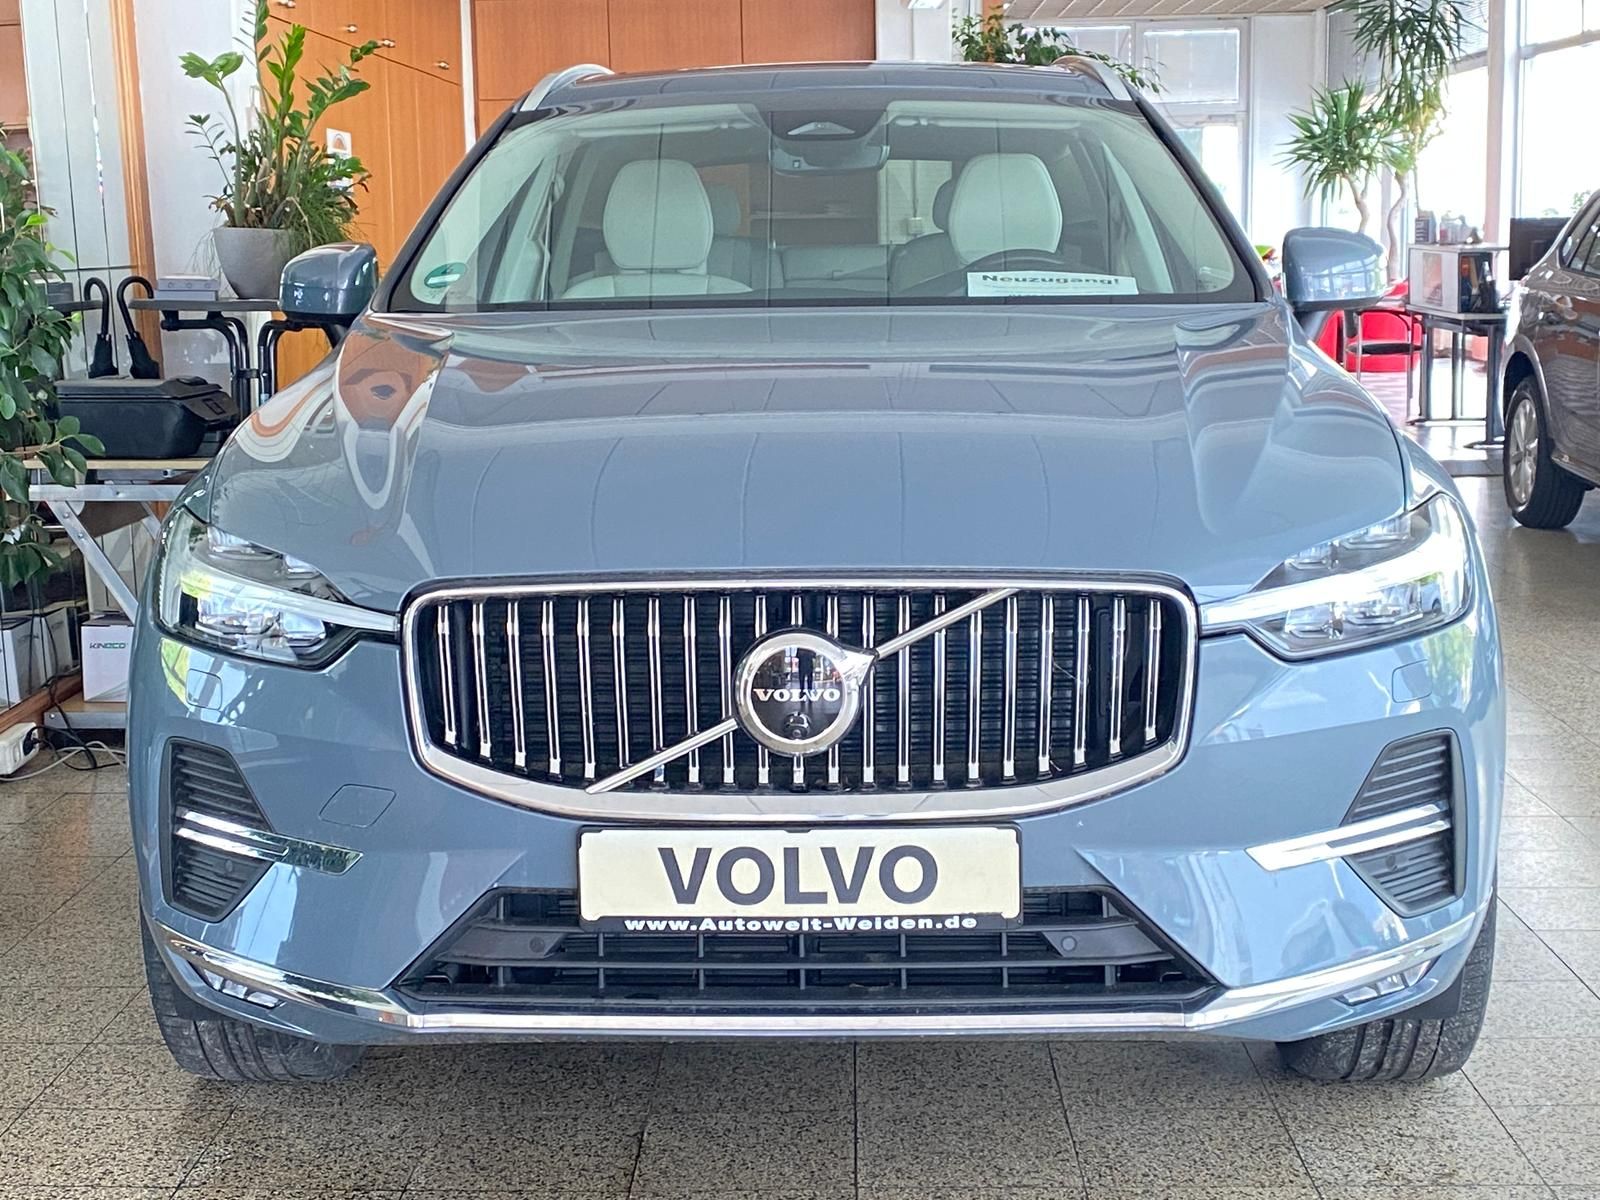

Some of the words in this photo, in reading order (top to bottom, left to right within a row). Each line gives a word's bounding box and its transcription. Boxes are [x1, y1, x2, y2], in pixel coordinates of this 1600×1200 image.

[982, 274, 1119, 285] Neuzugang!
[753, 689, 840, 702] VOLVO
[658, 845, 938, 905] VOLVO
[624, 915, 978, 931] www.Autowelt-Weiden.de
